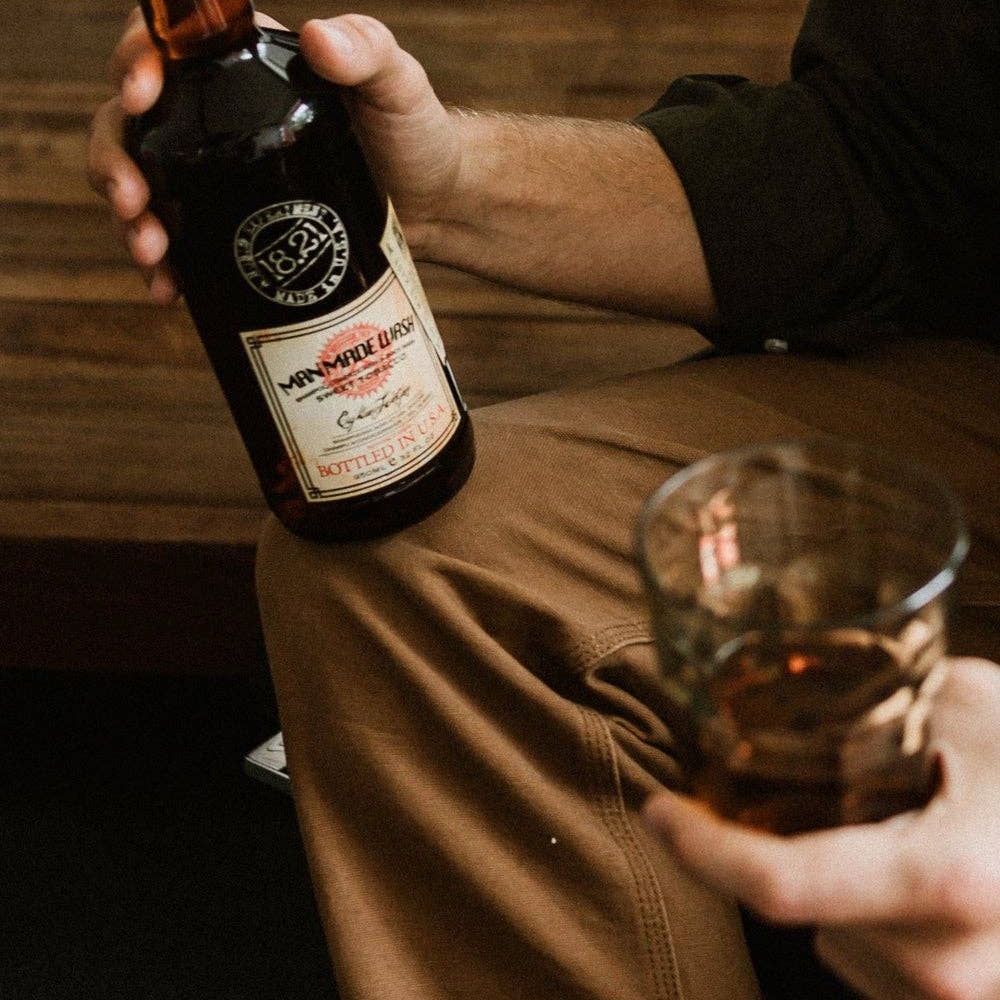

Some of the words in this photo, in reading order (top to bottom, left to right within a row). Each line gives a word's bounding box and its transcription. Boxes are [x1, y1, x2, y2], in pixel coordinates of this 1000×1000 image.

[259, 222, 328, 281] 18.21
[276, 289, 319, 304] MADE
[378, 315, 414, 348] WASH
[317, 444, 395, 478] BOTTLED
[398, 433, 416, 449] IN
